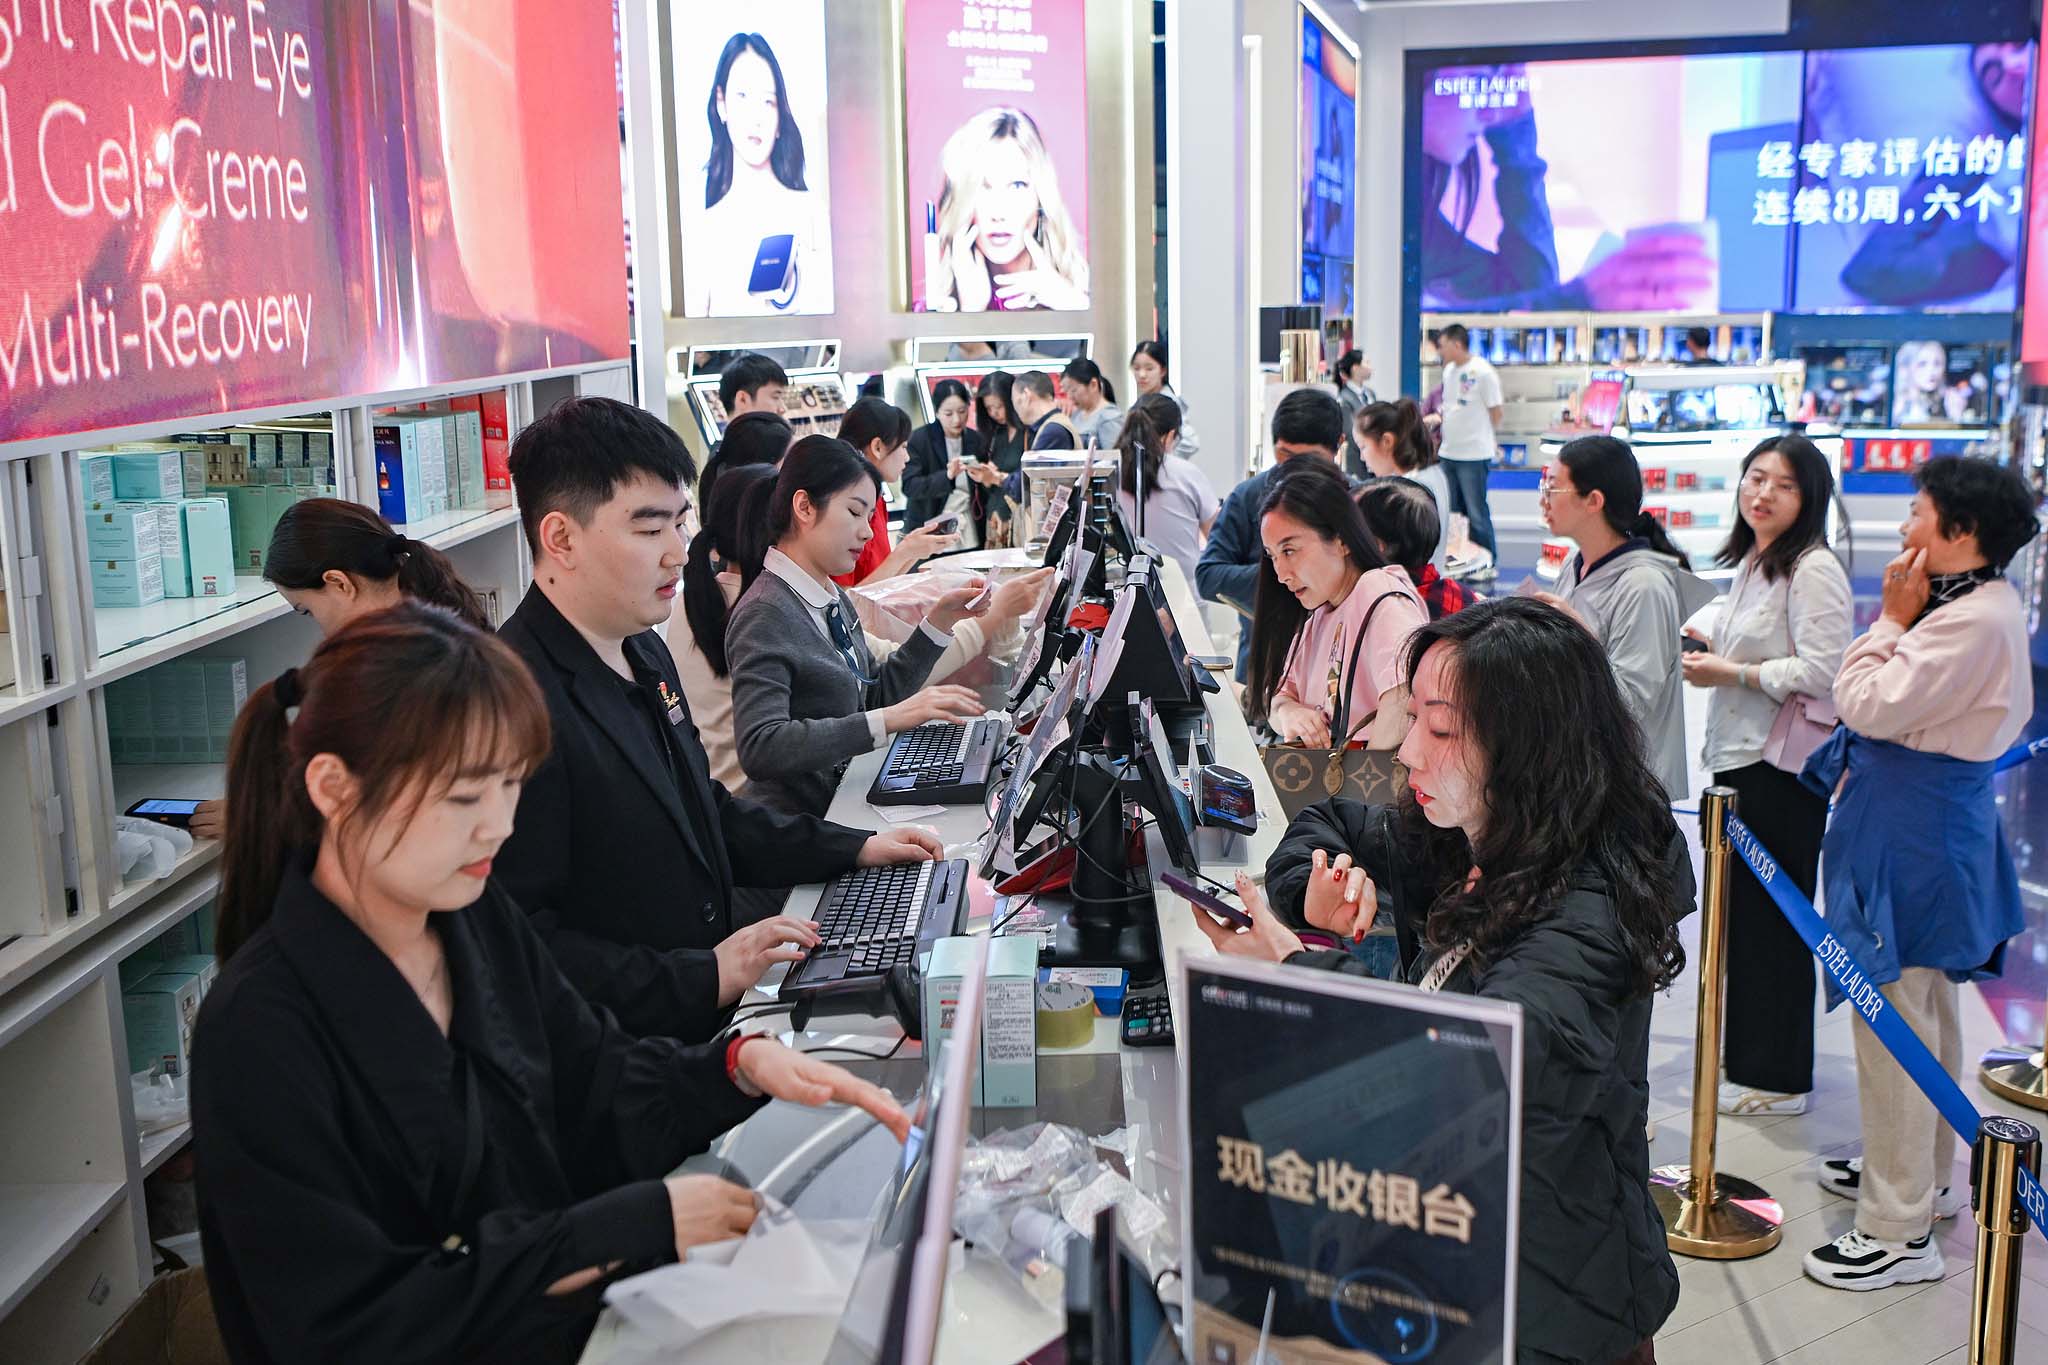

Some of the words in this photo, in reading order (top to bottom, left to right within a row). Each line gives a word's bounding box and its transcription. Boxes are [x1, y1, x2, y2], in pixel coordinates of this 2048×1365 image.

[90, 0, 236, 97] Repair
[246, 0, 312, 118] Eye
[1480, 75, 1541, 95] LAUDE
[38, 99, 310, 222] Gel-Creme
[0, 277, 313, 389] Multi-Recovery
[1743, 834, 1777, 884] LAUDER
[1839, 963, 1885, 1023] LAUDER
[1215, 1134, 1478, 1245] 现金收银台
